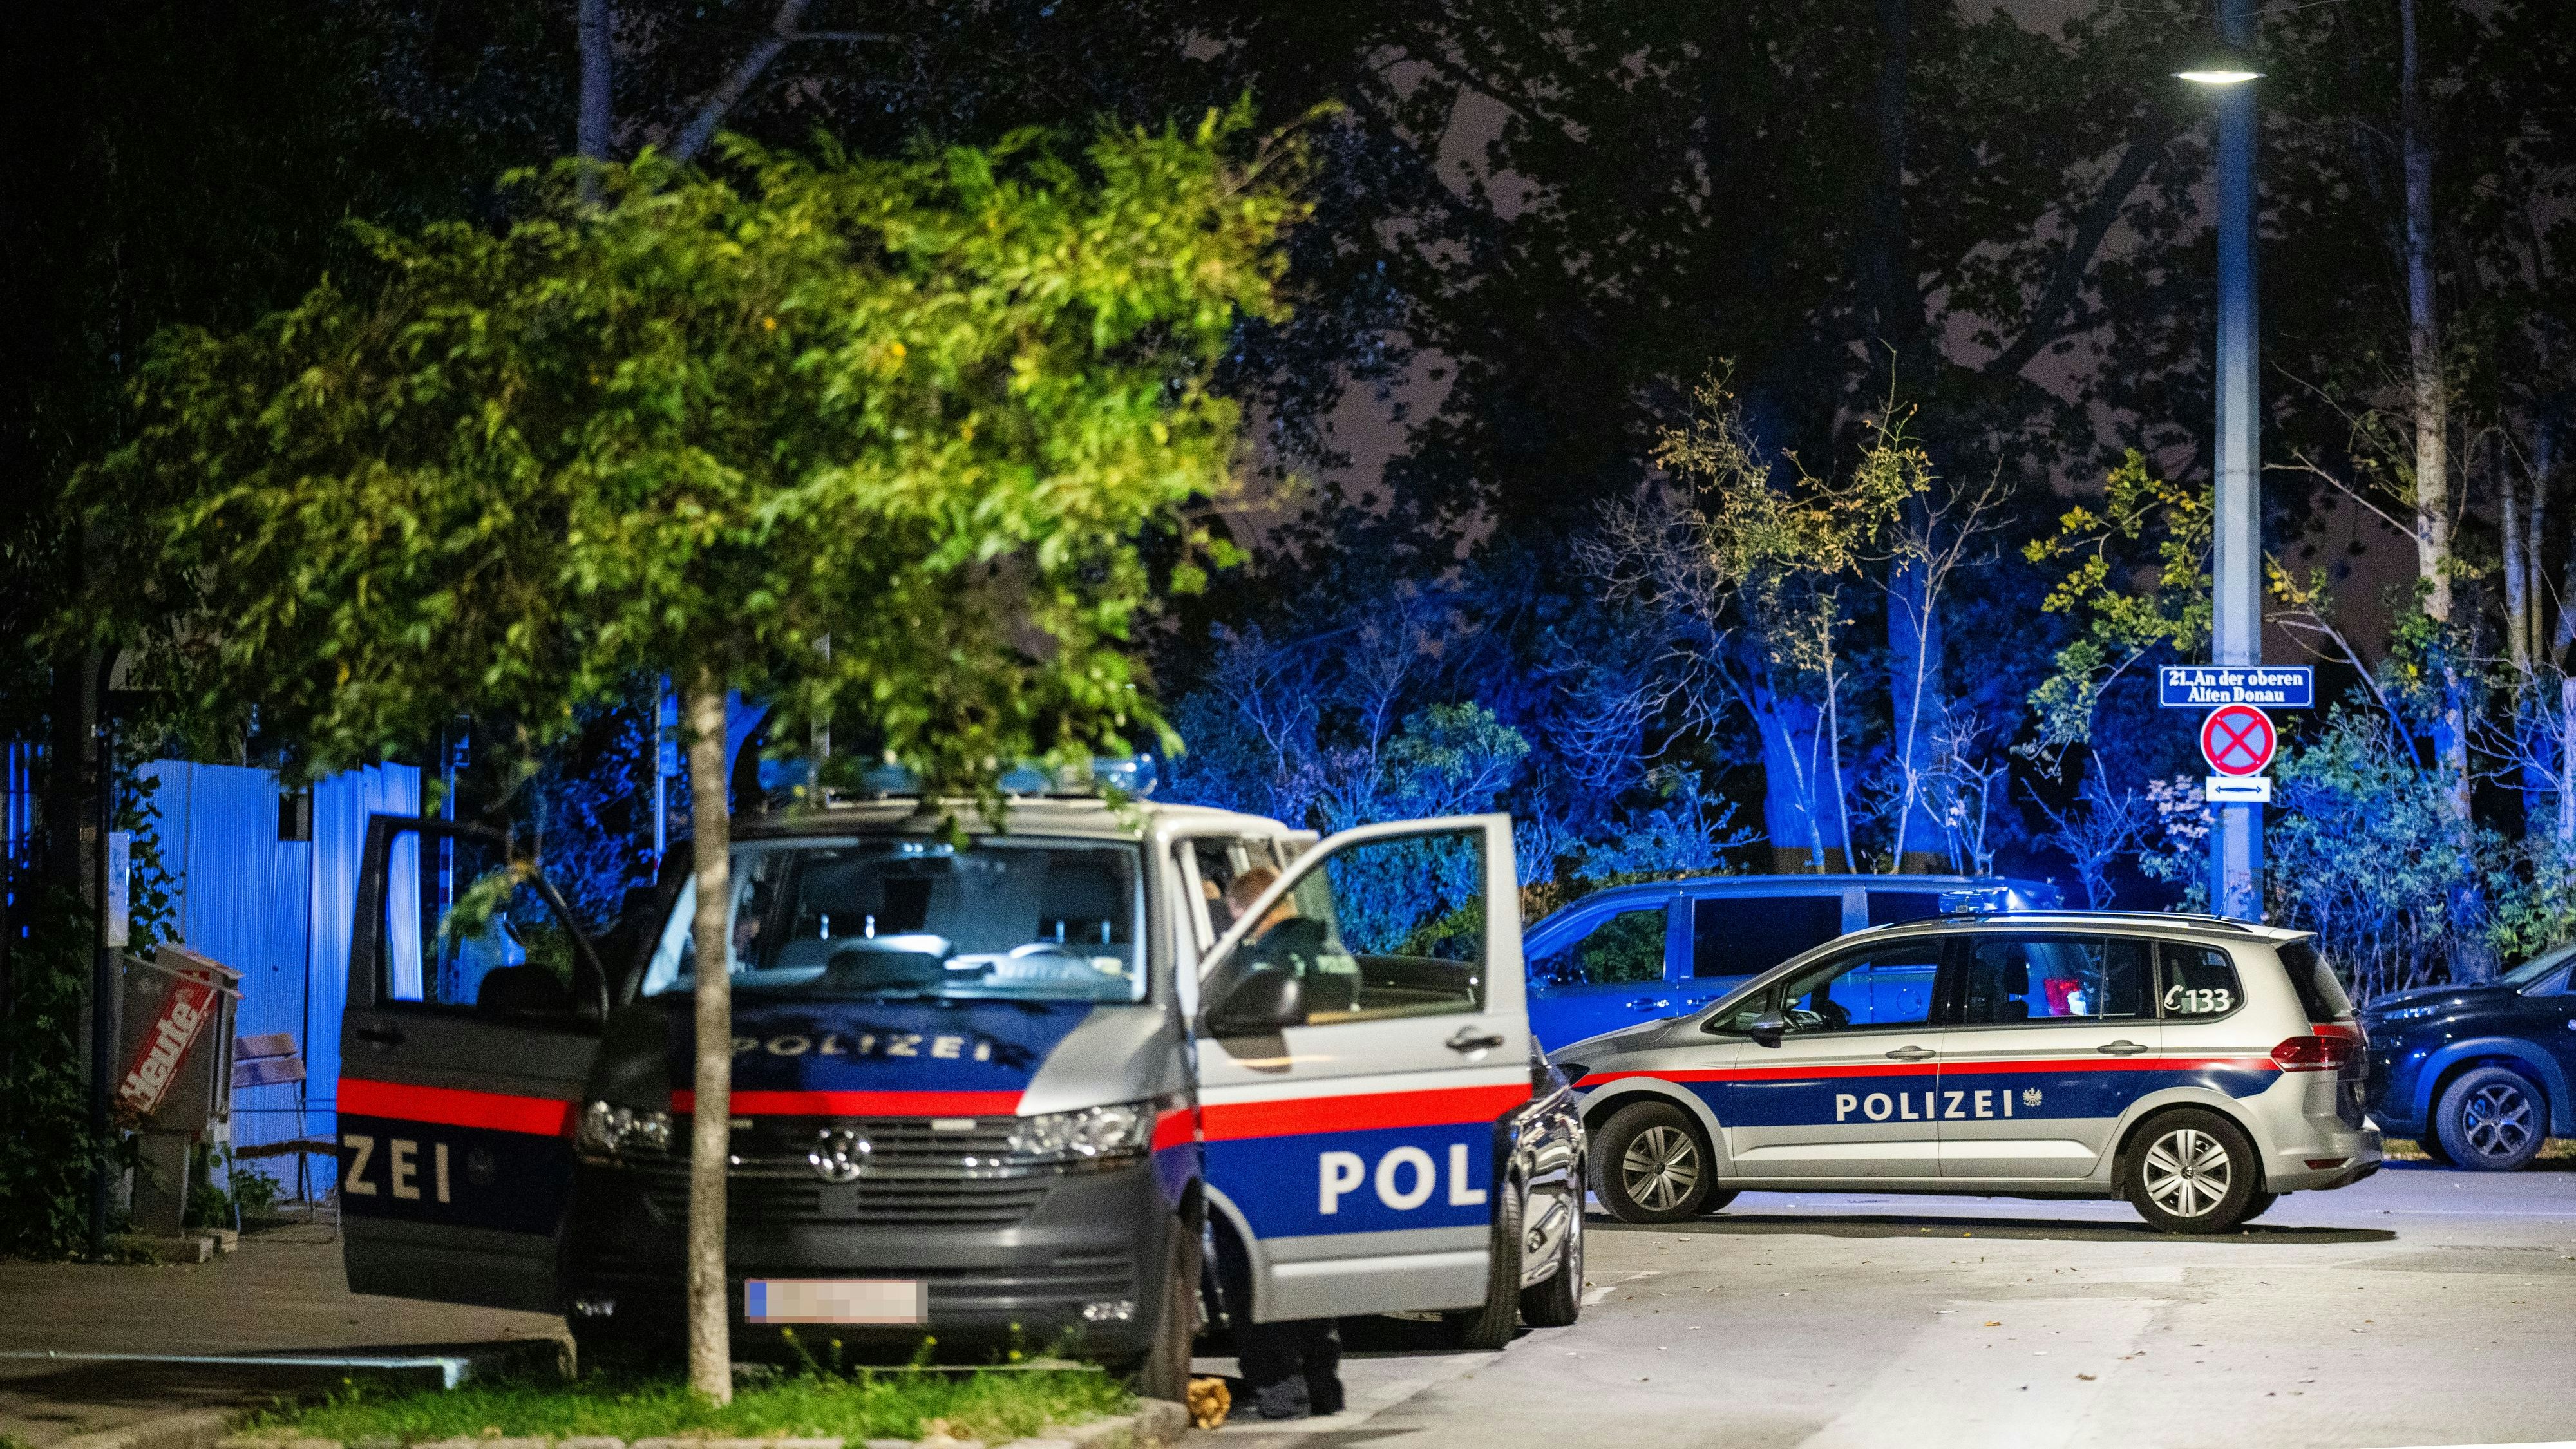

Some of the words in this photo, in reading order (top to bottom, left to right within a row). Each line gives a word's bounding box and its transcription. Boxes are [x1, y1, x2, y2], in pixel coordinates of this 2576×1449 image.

[2193, 670, 2216, 686] An
[2219, 670, 2244, 686] der
[2248, 670, 2304, 686] oberen
[2188, 687, 2231, 702] Alten
[2233, 687, 2285, 702] Donau
[2186, 989, 2230, 1012] 133
[119, 1001, 201, 1112] Heute
[730, 1034, 992, 1061] POLIZEI
[1836, 1090, 2013, 1121] POLIZEI
[343, 1134, 450, 1203] ZEI
[1319, 1144, 1487, 1215] POL
